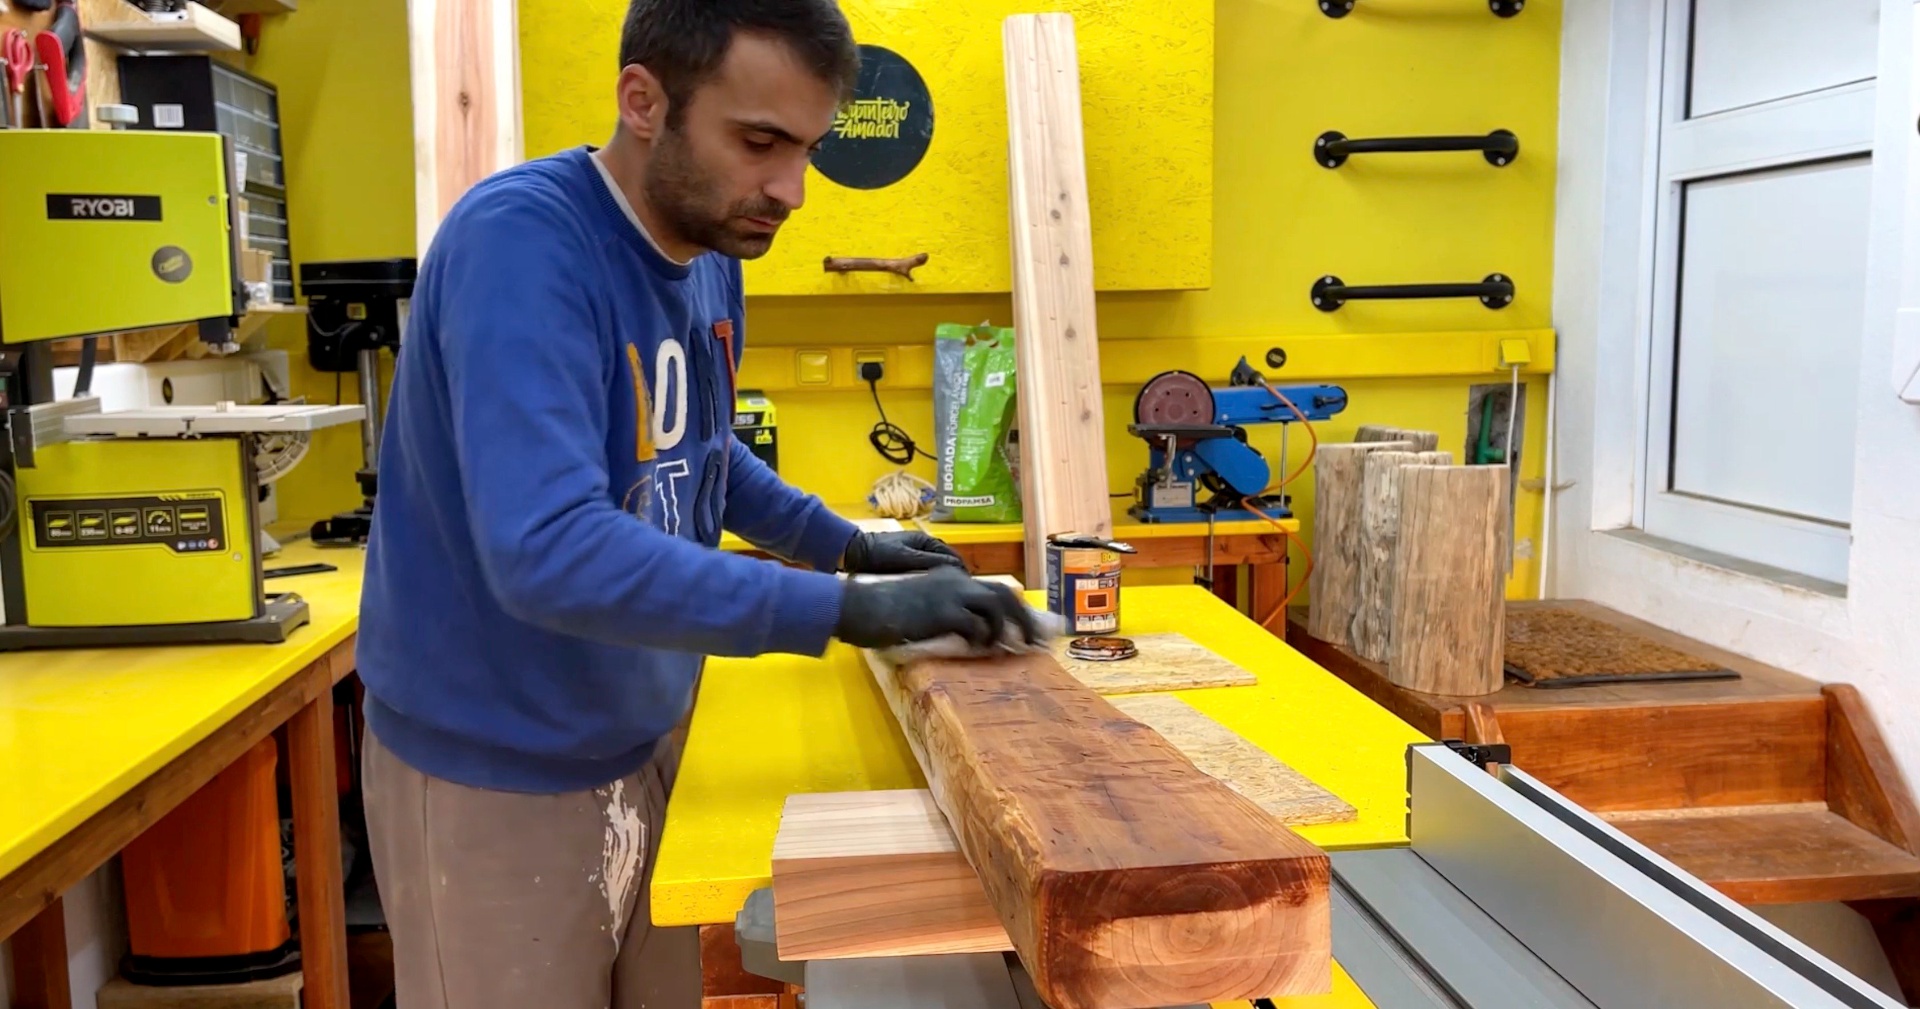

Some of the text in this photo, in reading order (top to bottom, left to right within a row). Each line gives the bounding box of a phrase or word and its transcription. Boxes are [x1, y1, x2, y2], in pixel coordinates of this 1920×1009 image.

[834, 119, 900, 139] Amador
[71, 198, 134, 217] RYOBI
[943, 437, 957, 491] BORADA
[945, 497, 992, 505] PROPAMSA
